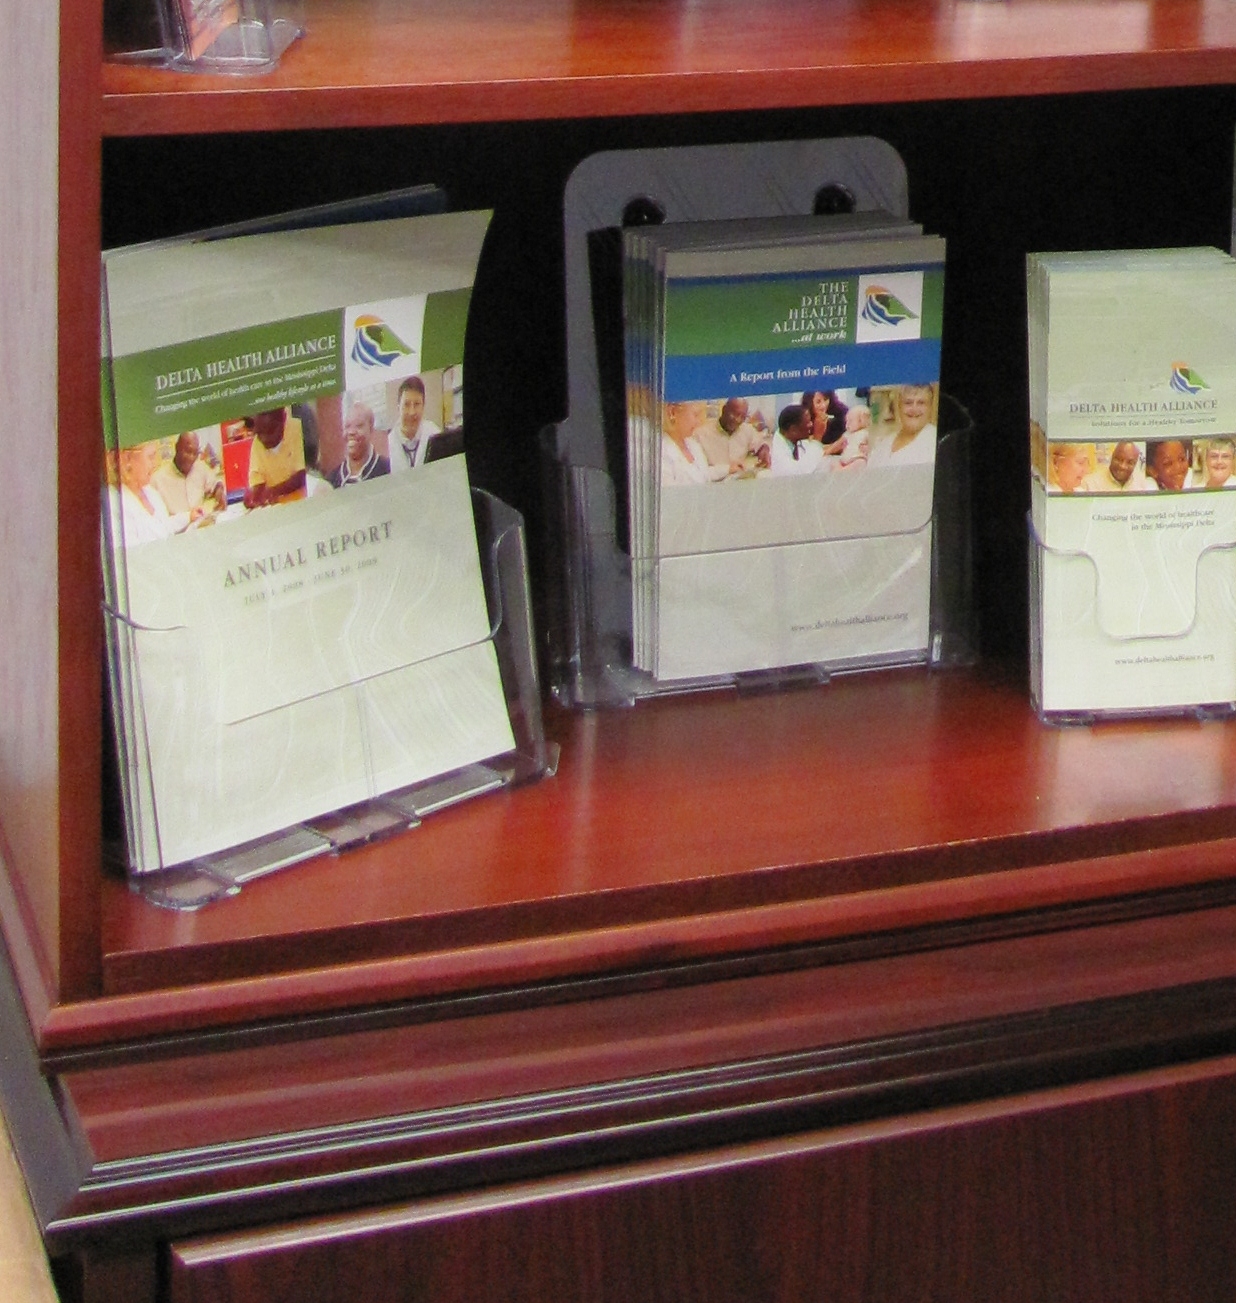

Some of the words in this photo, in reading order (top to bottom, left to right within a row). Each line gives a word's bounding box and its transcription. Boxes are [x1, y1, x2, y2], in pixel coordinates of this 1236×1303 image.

[820, 282, 849, 294] THE
[802, 294, 848, 306] DELTA
[789, 304, 848, 320] HEALTH
[772, 316, 848, 334] ALLIANCE
[816, 330, 846, 341] work
[156, 367, 202, 390] DELTA
[206, 353, 262, 378] HEALTH
[266, 334, 336, 364] ALLIANCE
[730, 374, 738, 382] A
[740, 371, 774, 384] Report
[777, 369, 801, 378] from
[803, 366, 820, 376] the
[822, 364, 846, 374] Field
[1070, 403, 1106, 414] DELTA
[1111, 402, 1157, 413] HEALTH
[1161, 400, 1218, 412] ALLIANCE
[224, 547, 307, 588] ANNUAL
[316, 520, 392, 559] REPORT
